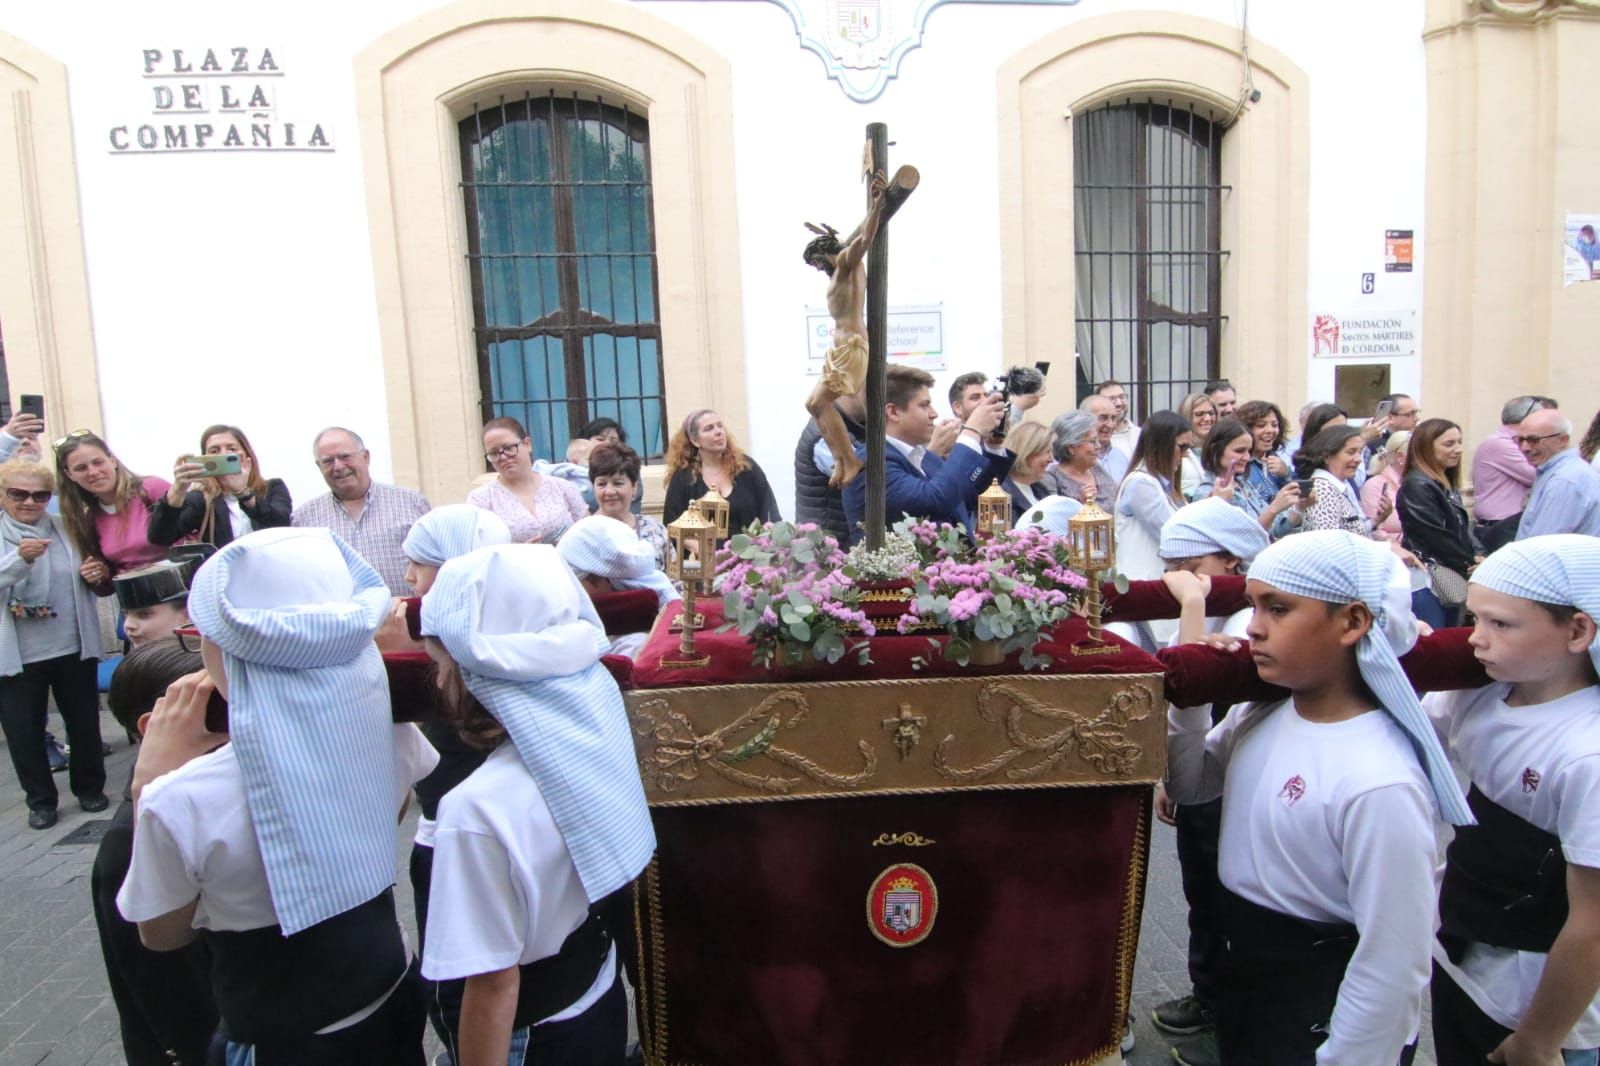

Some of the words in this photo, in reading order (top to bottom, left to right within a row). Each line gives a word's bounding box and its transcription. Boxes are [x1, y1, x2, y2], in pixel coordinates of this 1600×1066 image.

[143, 47, 279, 73] PLAZA
[153, 85, 202, 109] DE
[221, 85, 269, 109] LA
[109, 113, 330, 150] COMPAÑIA
[1363, 273, 1374, 293] 6
[887, 324, 934, 334] eference
